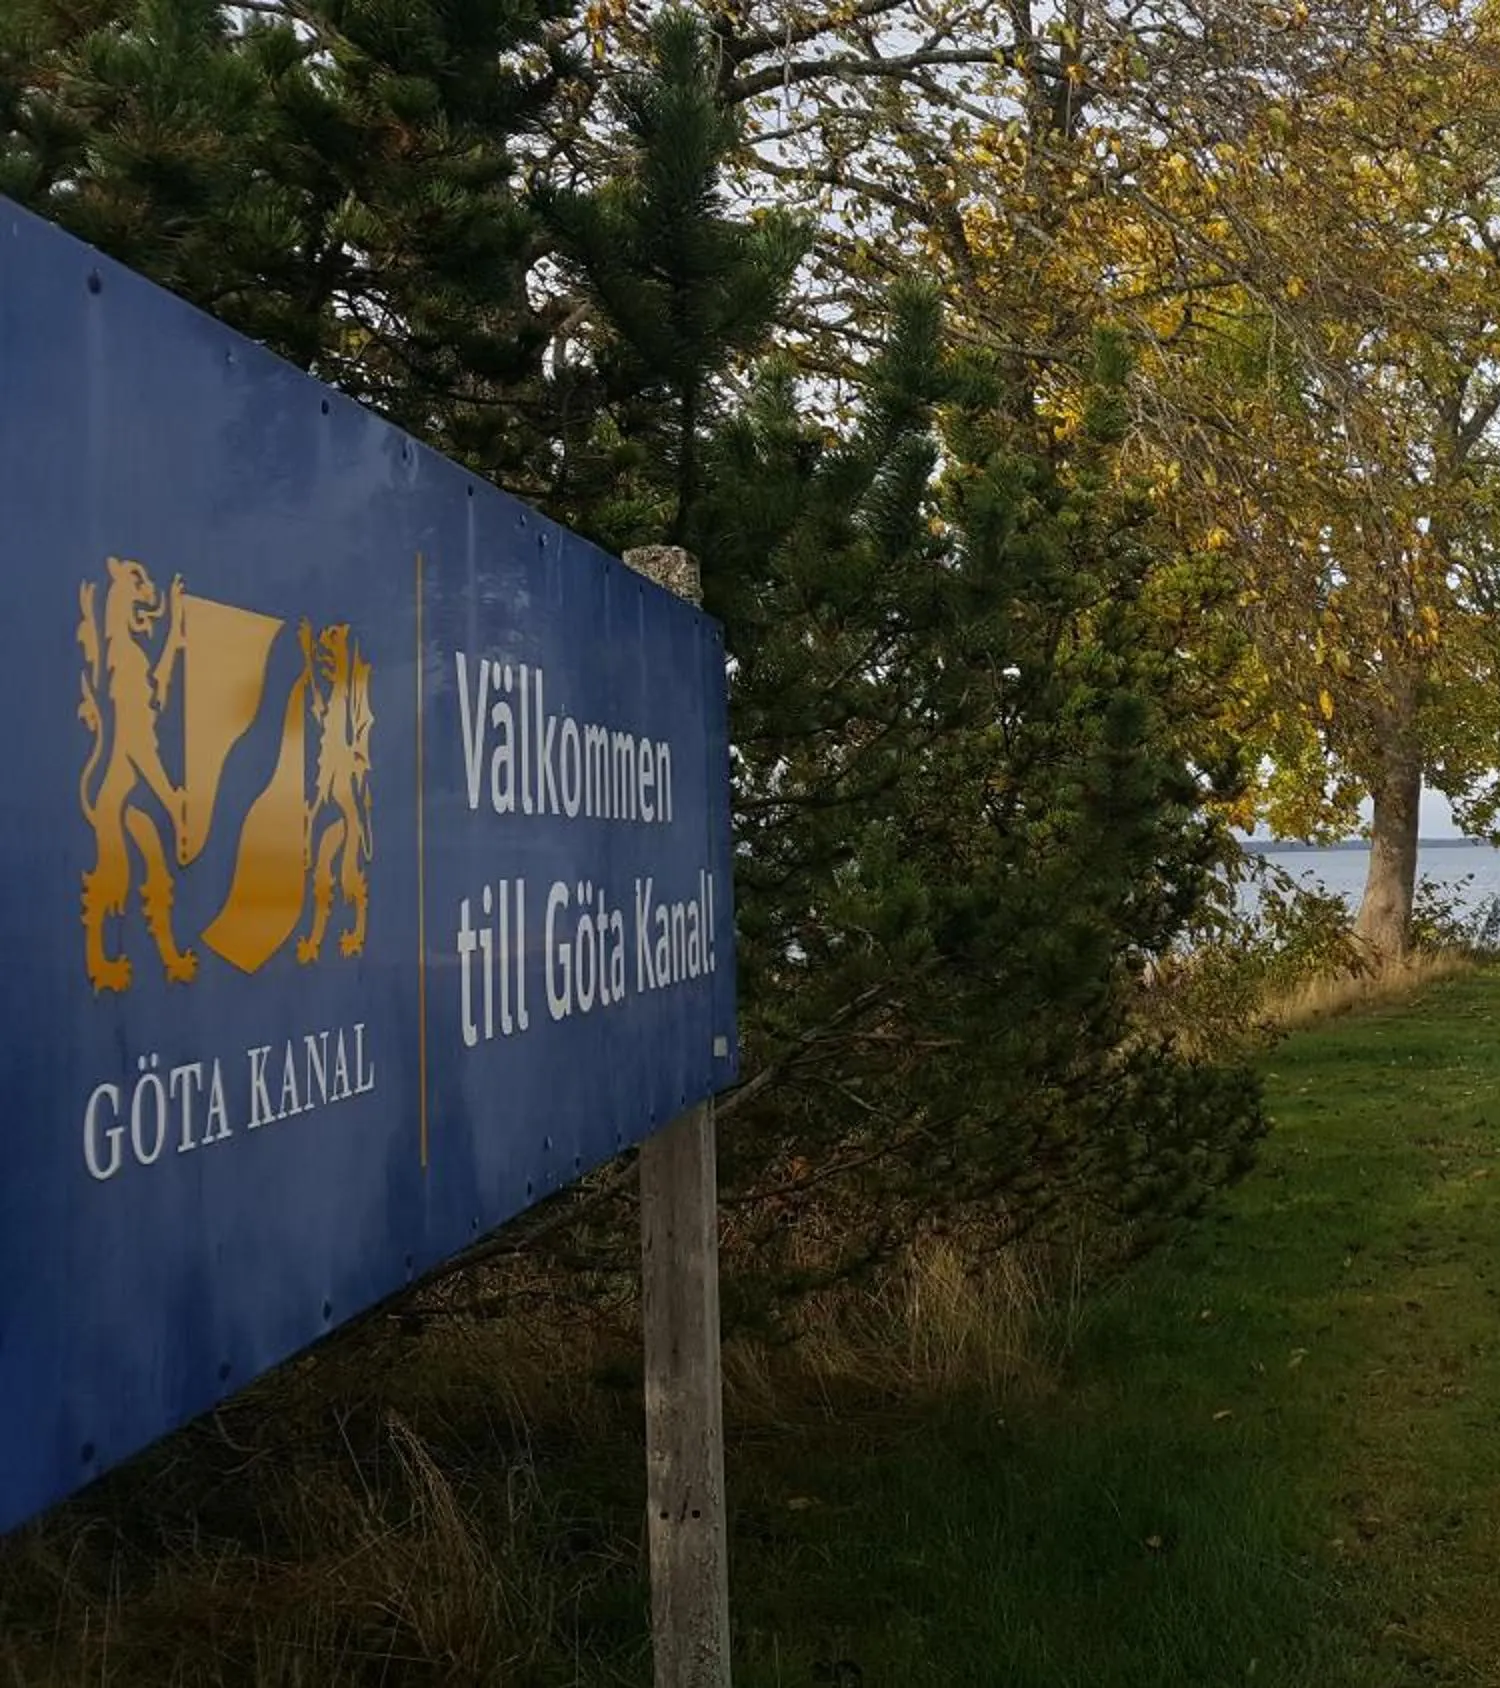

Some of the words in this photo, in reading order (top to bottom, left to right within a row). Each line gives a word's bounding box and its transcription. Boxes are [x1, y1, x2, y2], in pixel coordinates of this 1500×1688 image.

[455, 651, 673, 823] Välkommen
[456, 878, 528, 1047] till
[545, 880, 625, 1021] Göta
[635, 869, 716, 993] Kanal!
[83, 1053, 233, 1180] GÖTA
[247, 1023, 375, 1130] KANAL
